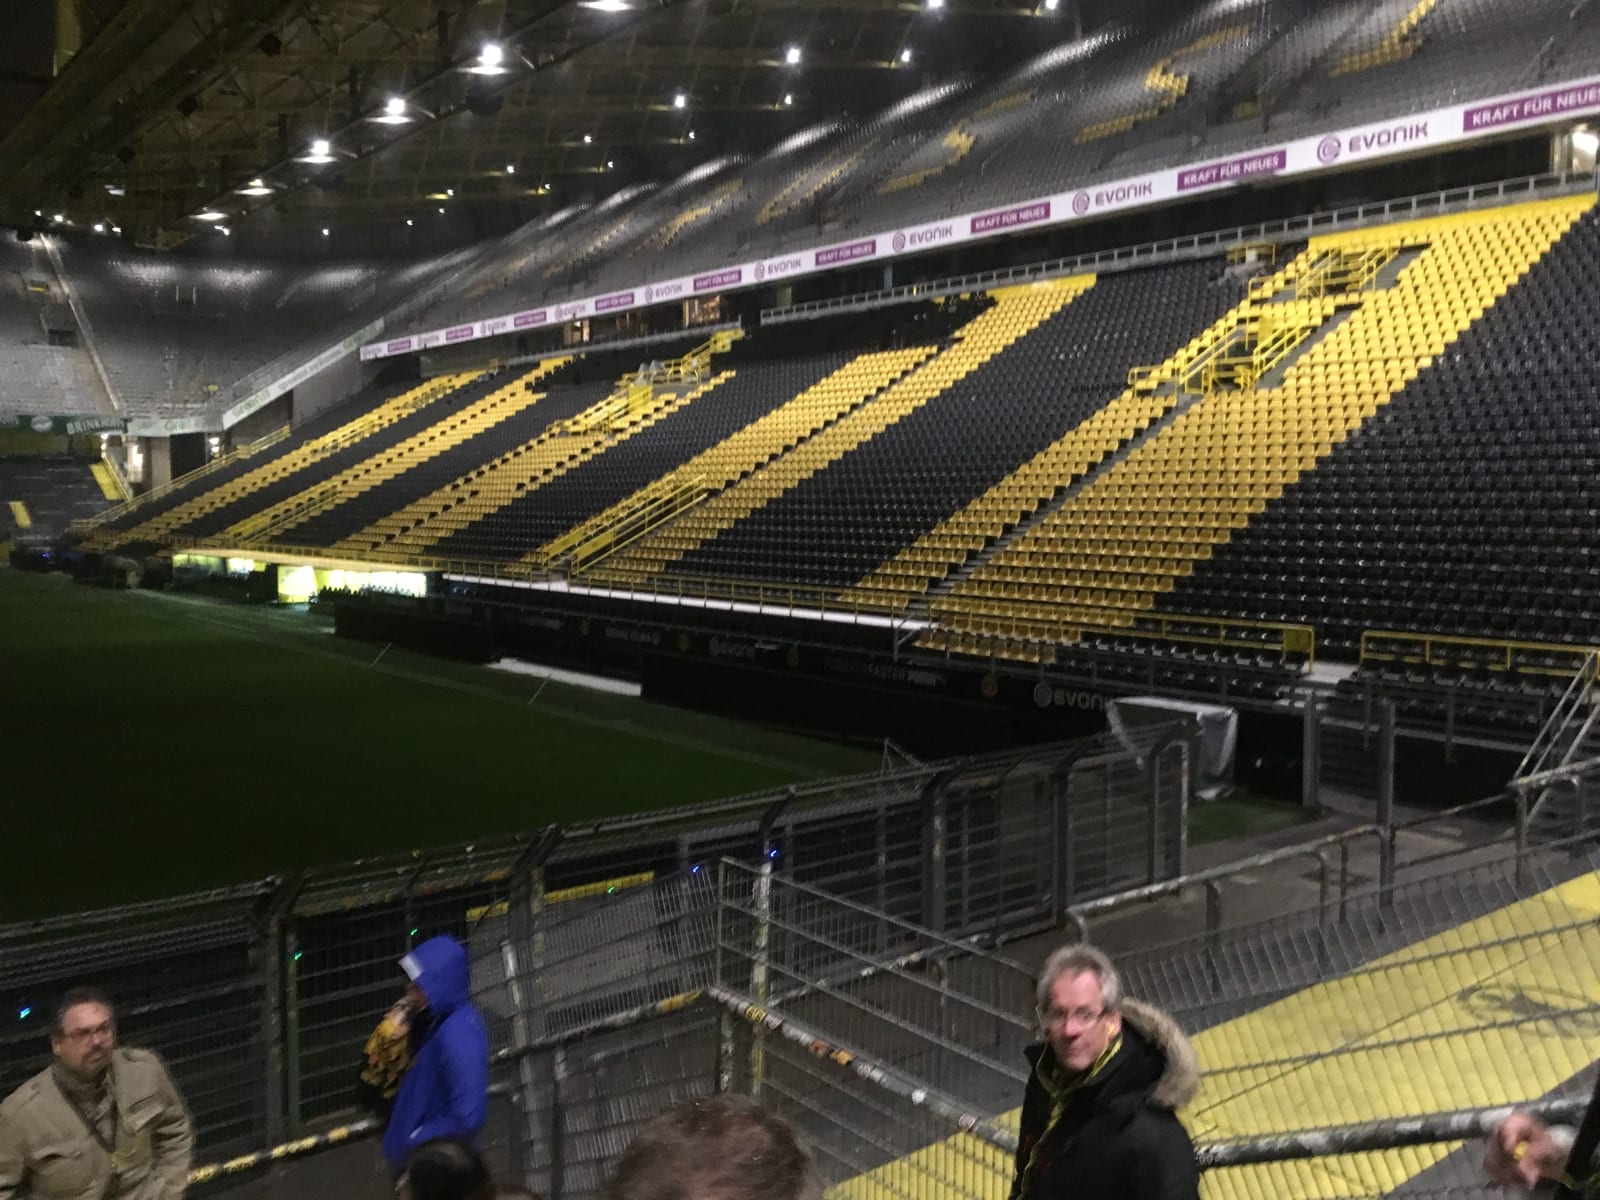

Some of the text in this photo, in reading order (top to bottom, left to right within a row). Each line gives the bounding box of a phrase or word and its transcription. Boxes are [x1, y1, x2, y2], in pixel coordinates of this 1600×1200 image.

[1472, 104, 1521, 126] KRAFT
[1523, 95, 1552, 116] FÜR
[1348, 121, 1428, 153] EVONIK
[1183, 154, 1280, 187] KRAFT FÜR NEUES
[1095, 181, 1152, 207] EVONIK
[975, 205, 1046, 231] KRAFT FÜR NEUES
[909, 225, 952, 246] EVONIK
[767, 258, 802, 274] EVONIK
